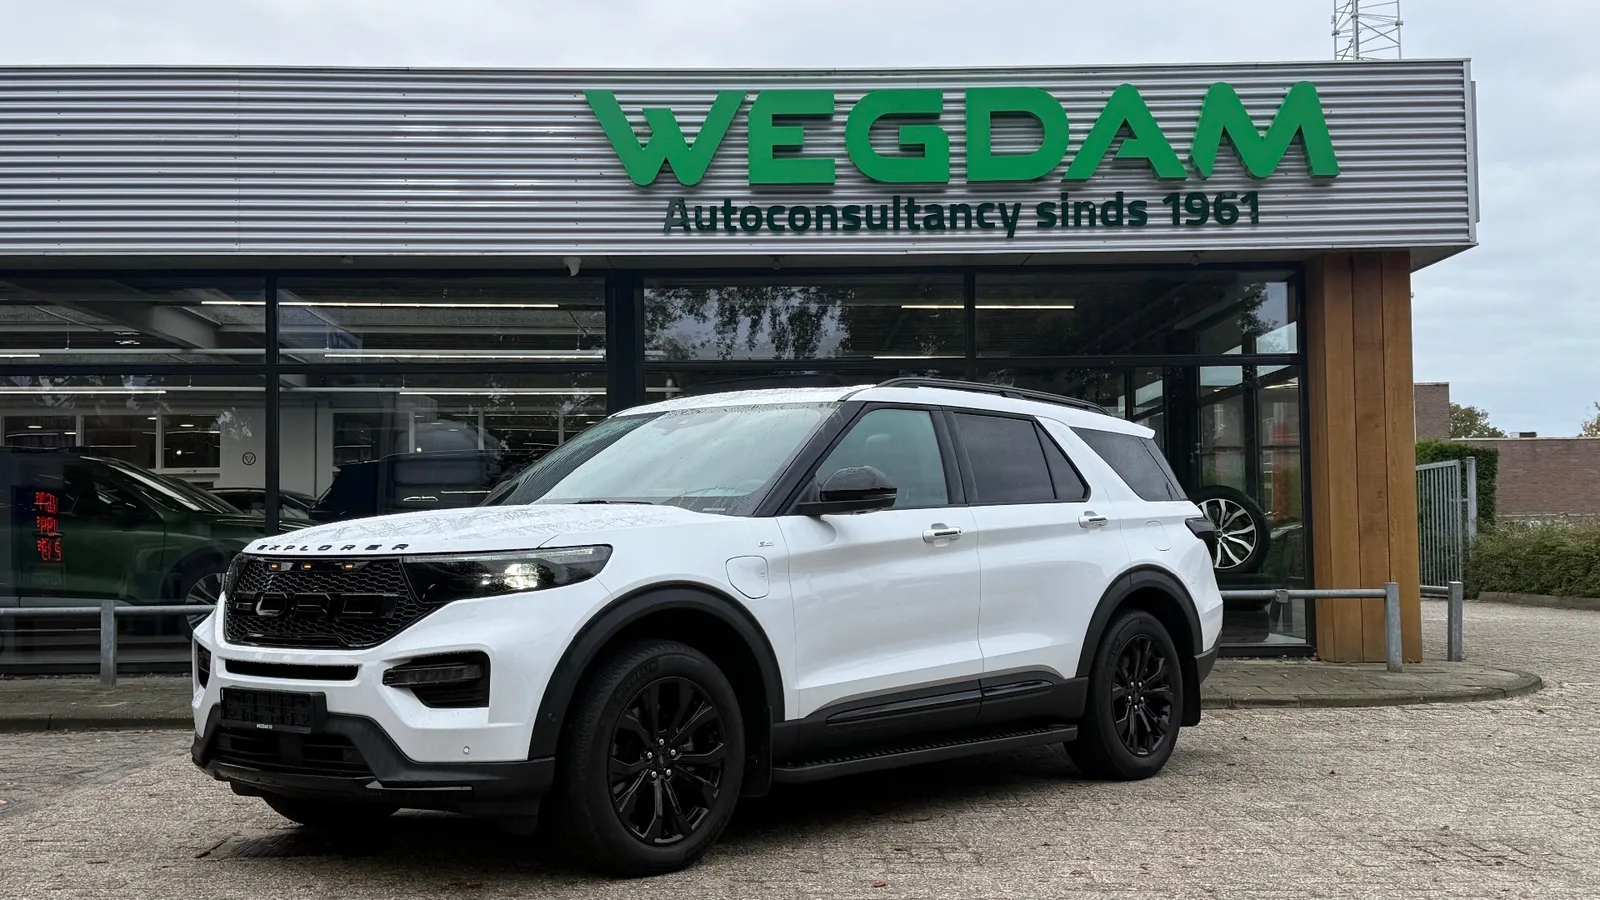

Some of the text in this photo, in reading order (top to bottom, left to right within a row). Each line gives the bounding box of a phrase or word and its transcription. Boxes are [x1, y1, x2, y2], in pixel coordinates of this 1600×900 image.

[583, 80, 1340, 187] WEGDAM
[664, 190, 1260, 238] Autoconsultancy sinds 1961
[256, 542, 410, 552] EXPLORER
